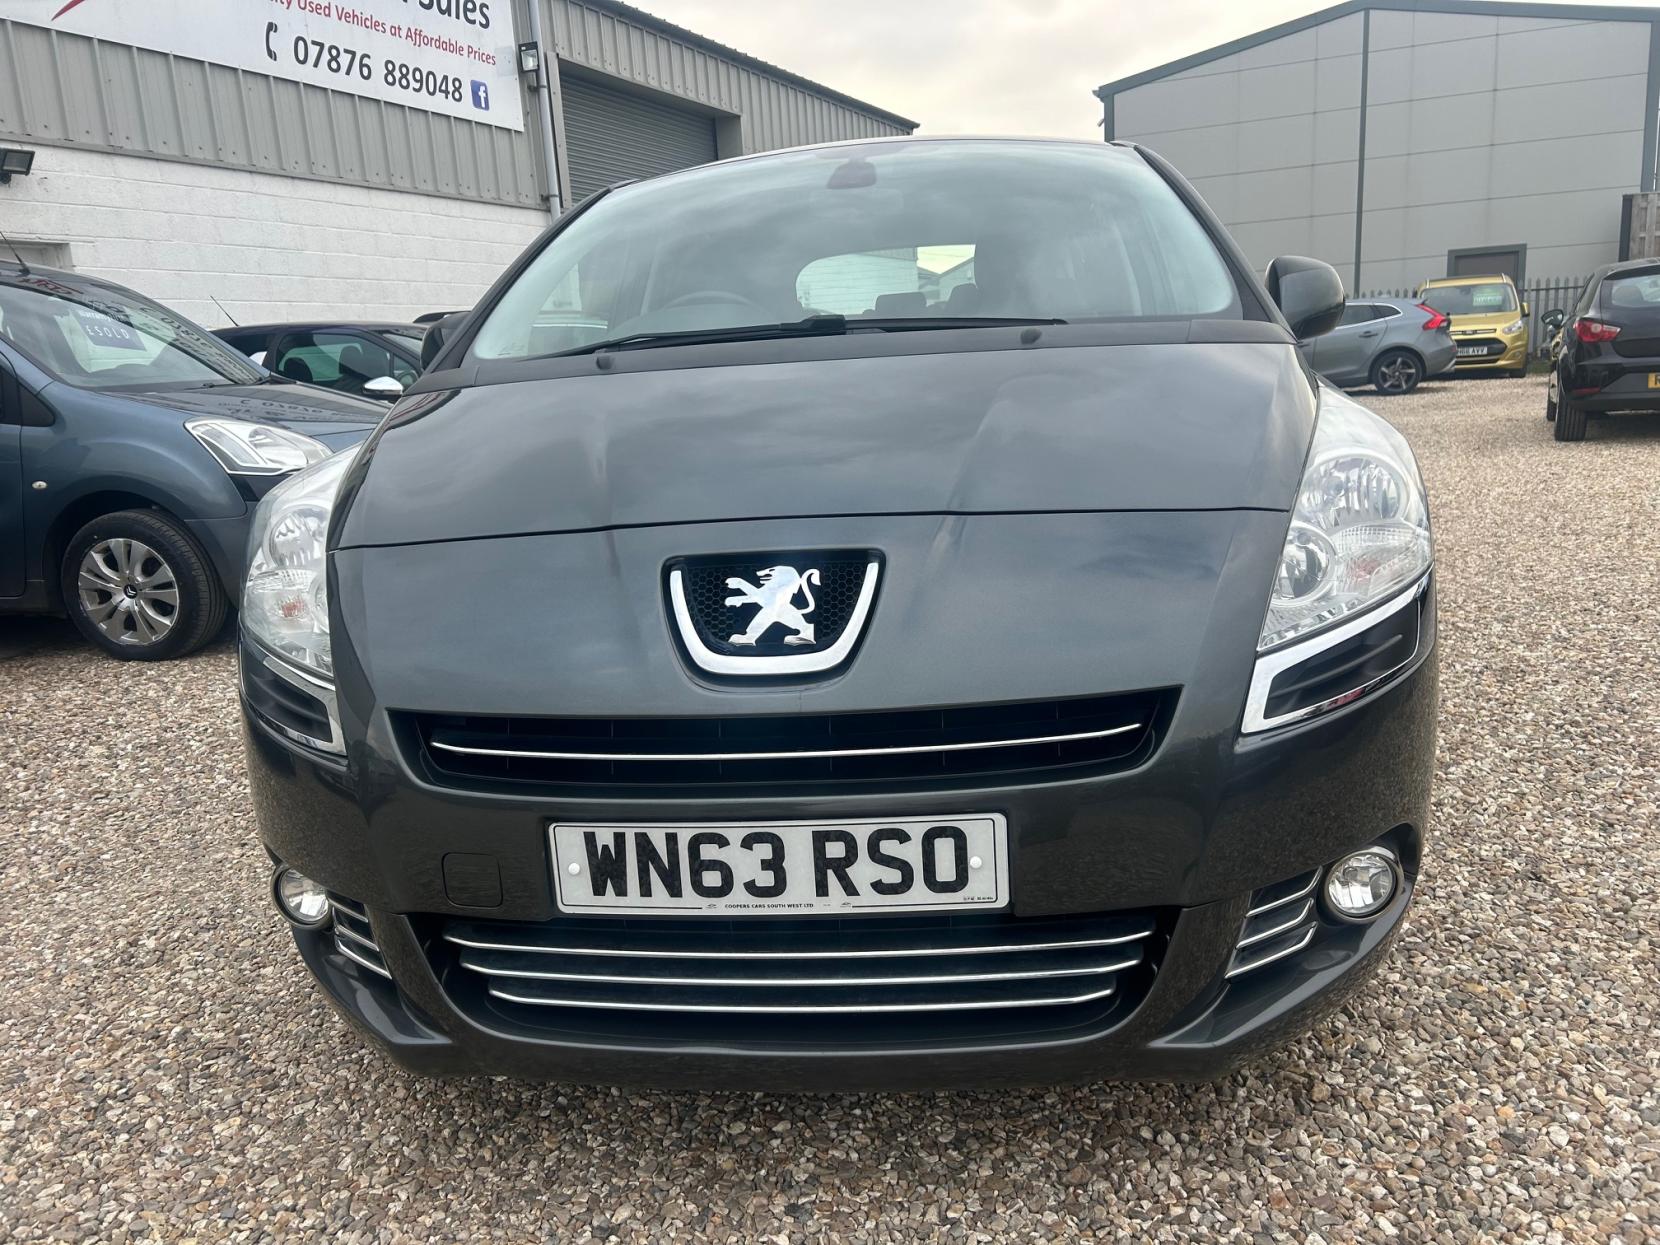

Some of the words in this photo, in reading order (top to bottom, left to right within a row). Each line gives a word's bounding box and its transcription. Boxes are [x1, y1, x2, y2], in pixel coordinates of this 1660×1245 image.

[297, 0, 331, 17] Used
[335, 5, 387, 34] Vehicles
[390, 24, 402, 39] at
[405, 27, 464, 57] Affordable
[467, 44, 496, 66] Prices
[419, 0, 490, 29] ales
[293, 35, 372, 81] 07876
[384, 59, 463, 103] 889048
[583, 831, 787, 898] WN63
[811, 826, 969, 897] RSO
